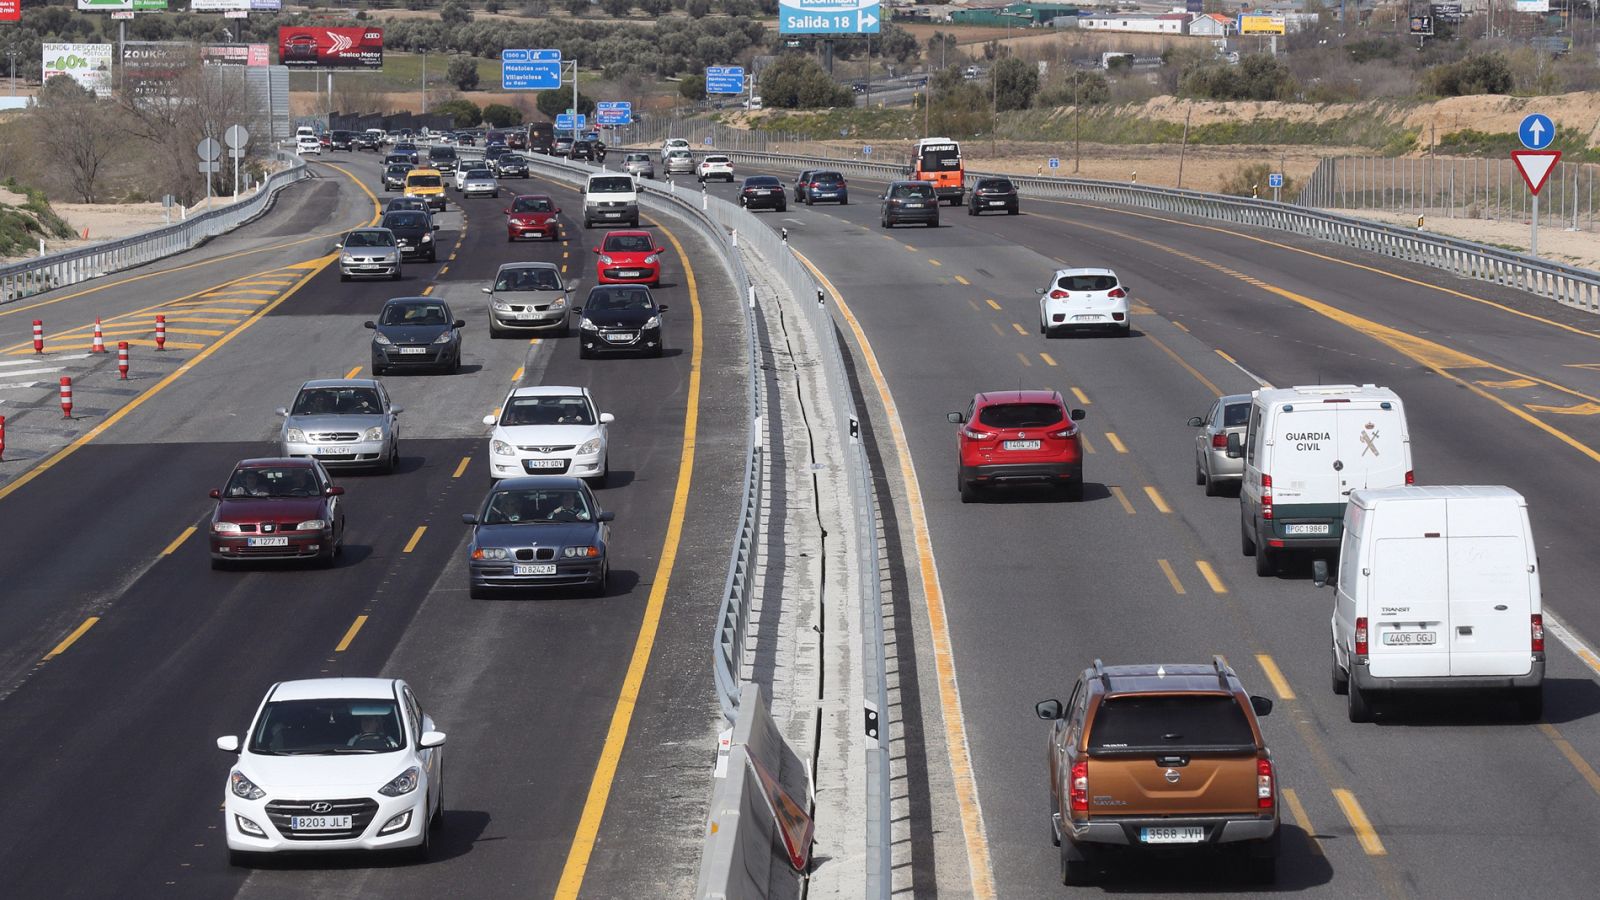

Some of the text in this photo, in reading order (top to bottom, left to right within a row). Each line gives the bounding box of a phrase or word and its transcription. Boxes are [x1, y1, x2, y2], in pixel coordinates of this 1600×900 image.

[787, 15, 850, 28] Salida 18
[46, 55, 88, 71] -60%
[1285, 432, 1331, 442] GUARDIA
[1295, 442, 1321, 452] CIVIL
[1389, 633, 1433, 643] 4406 GGJ
[299, 817, 350, 828] 8203 JLF
[1149, 828, 1203, 840] 3568 JVH
